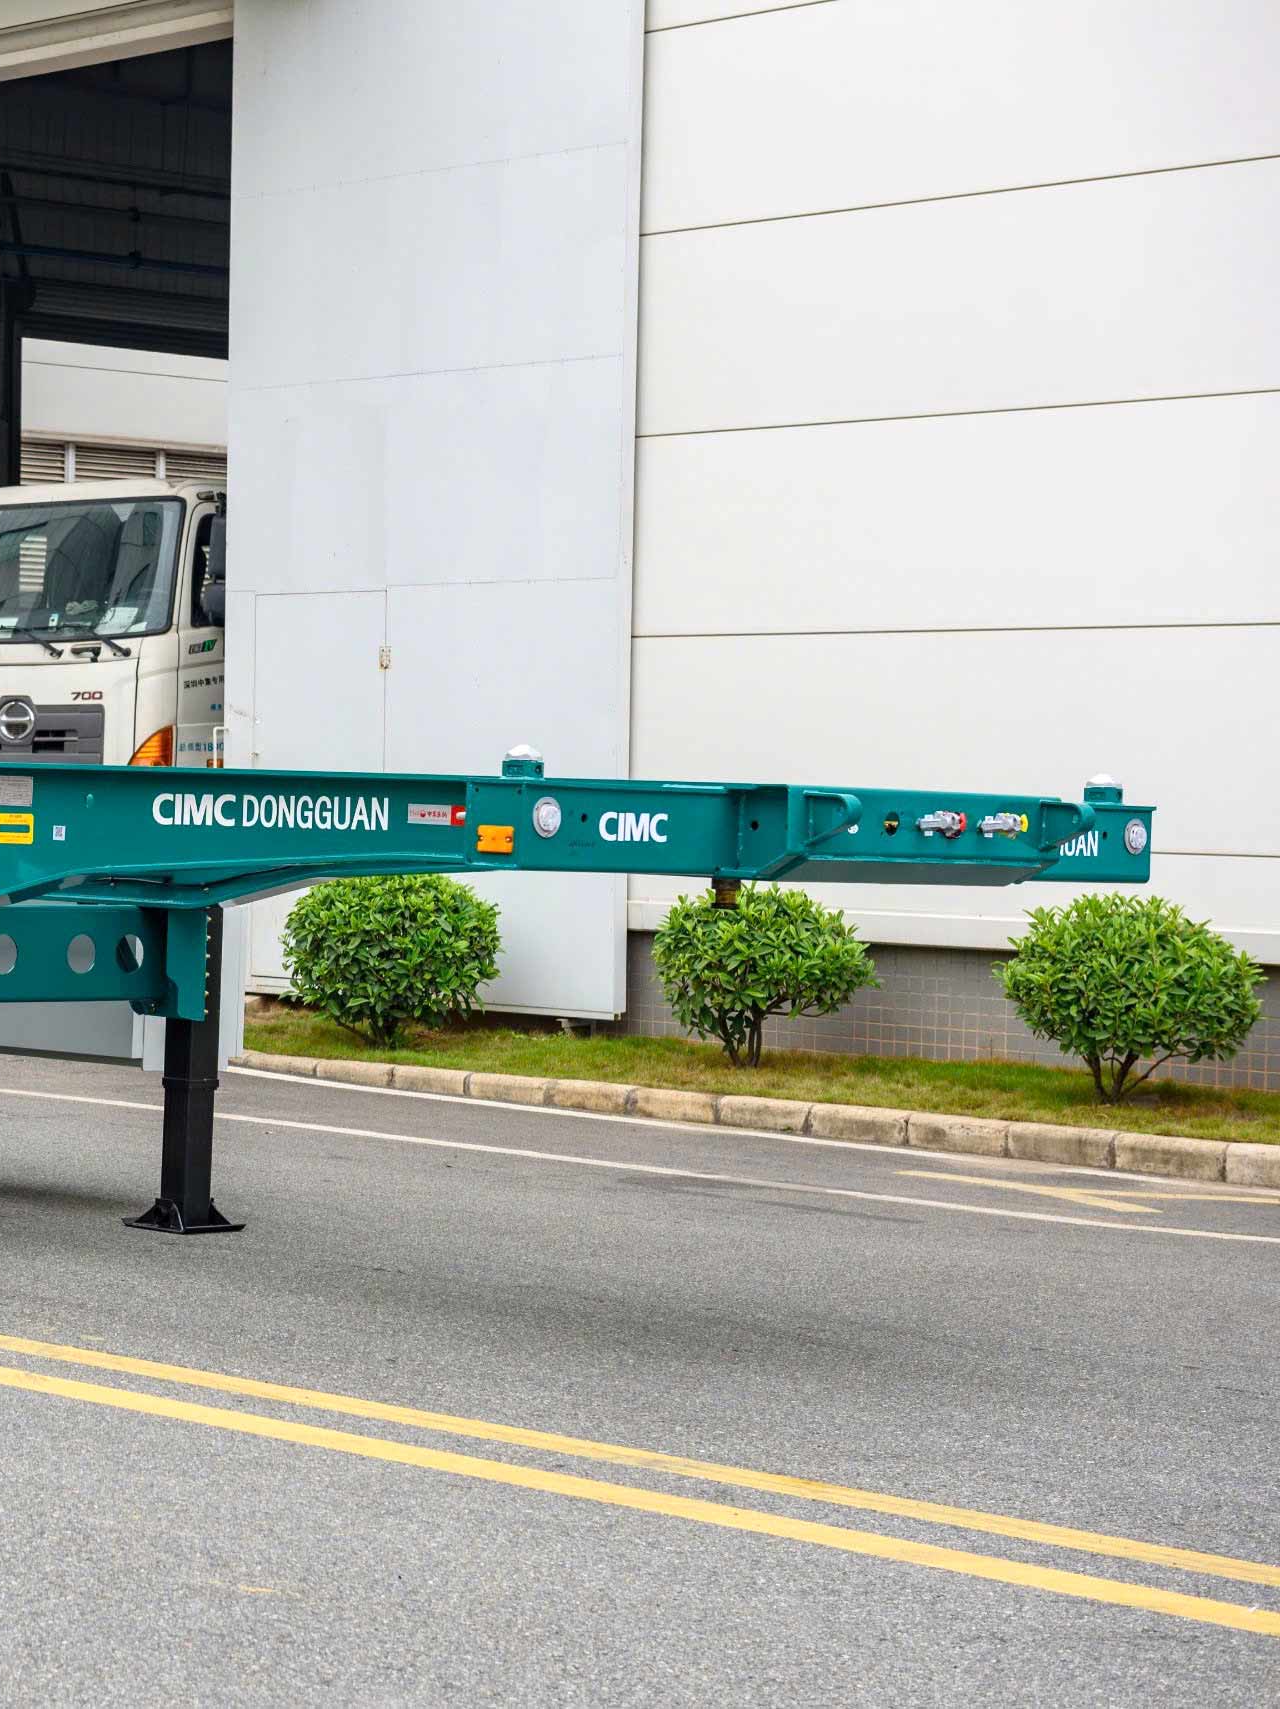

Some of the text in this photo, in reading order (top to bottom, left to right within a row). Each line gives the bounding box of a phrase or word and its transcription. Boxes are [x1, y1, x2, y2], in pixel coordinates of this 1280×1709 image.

[71, 691, 103, 701] 700
[152, 793, 389, 831] CIMC DONGGUAN
[599, 811, 668, 843] CIMC
